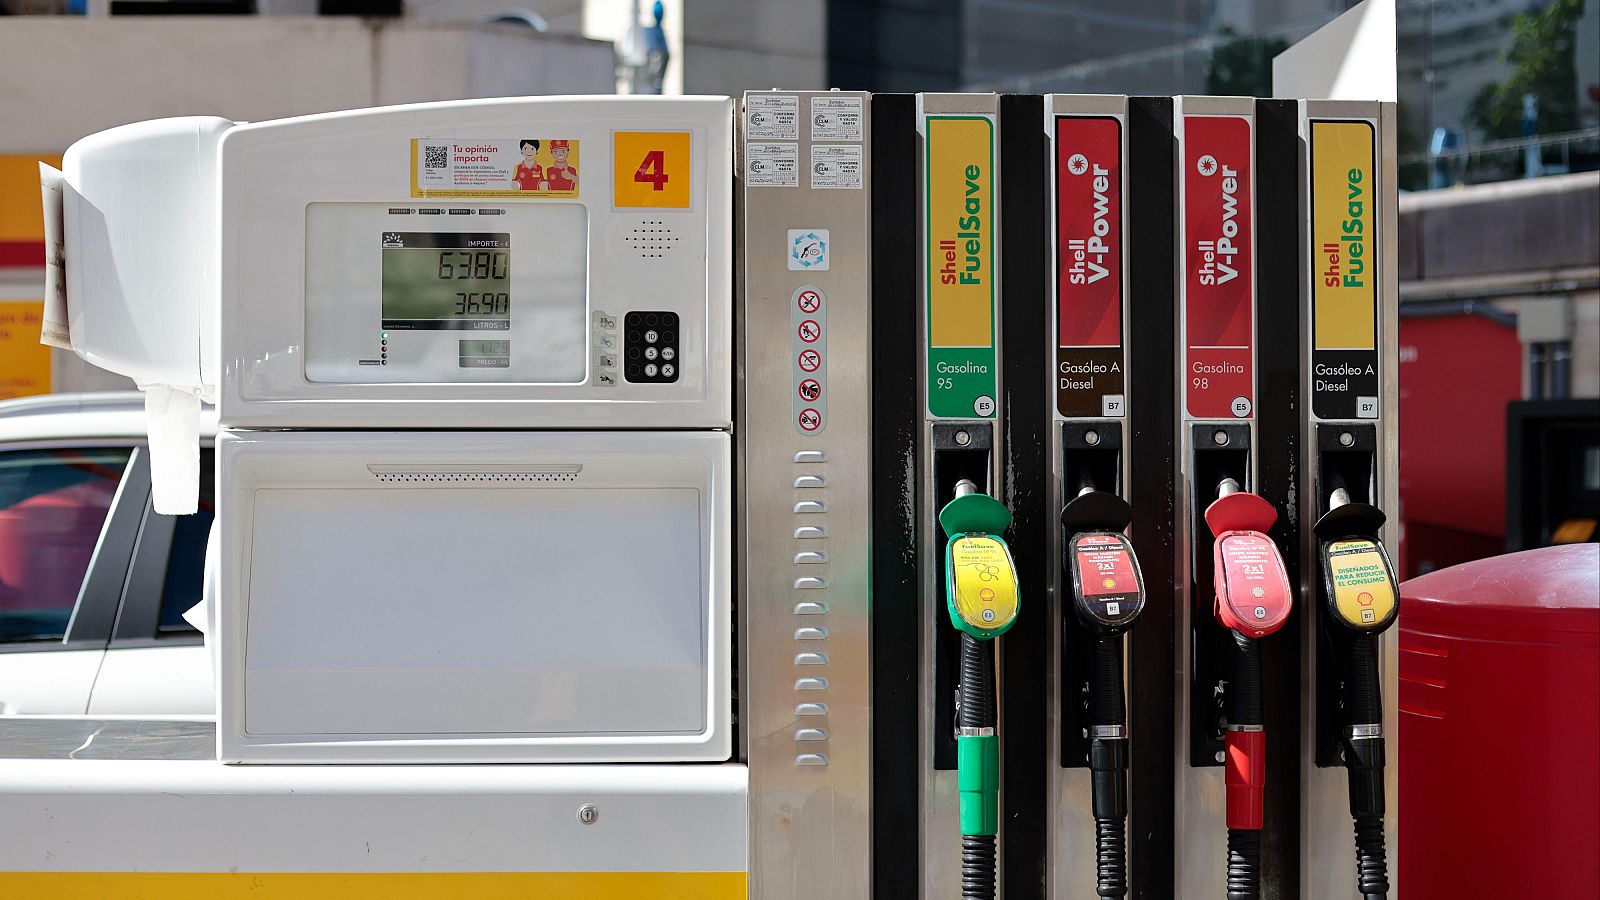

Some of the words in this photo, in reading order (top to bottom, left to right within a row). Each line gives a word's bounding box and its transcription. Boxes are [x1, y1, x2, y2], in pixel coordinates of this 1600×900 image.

[465, 145, 497, 154] opinión
[454, 154, 489, 164] importa
[634, 150, 668, 191] 4
[958, 164, 980, 285] FuelSave
[1088, 164, 1109, 284] V-Power
[1217, 165, 1239, 285] V-Power
[1341, 168, 1363, 287] FuelSave
[439, 252, 508, 279] 63.80
[940, 240, 956, 285] Shell
[1069, 239, 1085, 284] Shell
[1198, 241, 1214, 285] Shell
[1324, 244, 1339, 287] Shell
[455, 293, 508, 315] 36.90
[937, 361, 987, 374] Gasolina
[1060, 361, 1107, 374] Gasóleo
[1110, 362, 1120, 373] A
[1193, 361, 1244, 374] Gasolina
[1316, 363, 1362, 376] Gasóleo
[1365, 365, 1374, 375] A
[937, 378, 952, 389] 95
[1060, 377, 1094, 389] Diesel
[1193, 377, 1208, 389] 98
[1316, 379, 1348, 392] Diesel
[979, 402, 990, 410] E5
[1108, 402, 1119, 410] B7
[1338, 564, 1379, 574] DISEÑADOS
[1356, 570, 1385, 578] REDUCIR
[1347, 576, 1385, 585] CONSUMO
